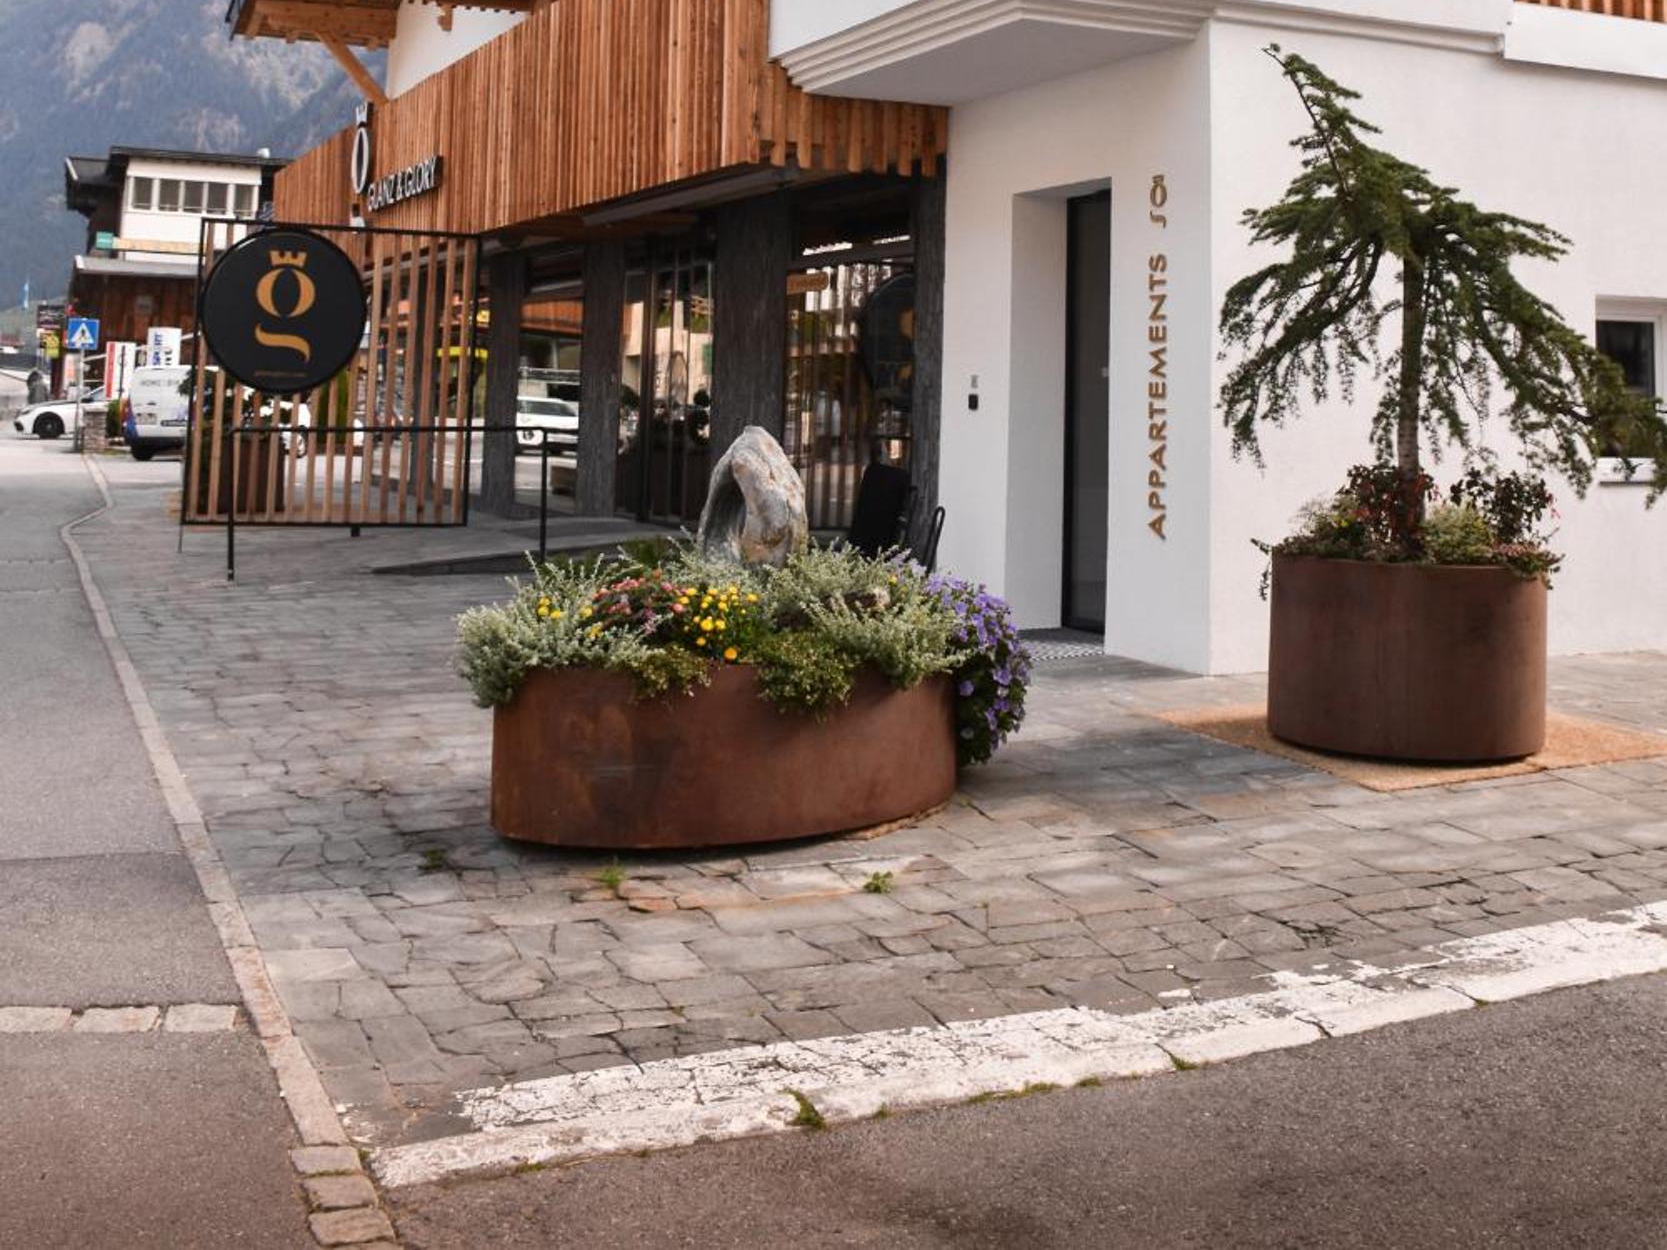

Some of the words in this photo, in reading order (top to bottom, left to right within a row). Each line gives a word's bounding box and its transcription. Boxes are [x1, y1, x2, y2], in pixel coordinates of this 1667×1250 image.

[368, 175, 395, 211] GLANZ
[405, 157, 437, 197] GLORY
[1149, 253, 1167, 541] APPARTEMENTS
